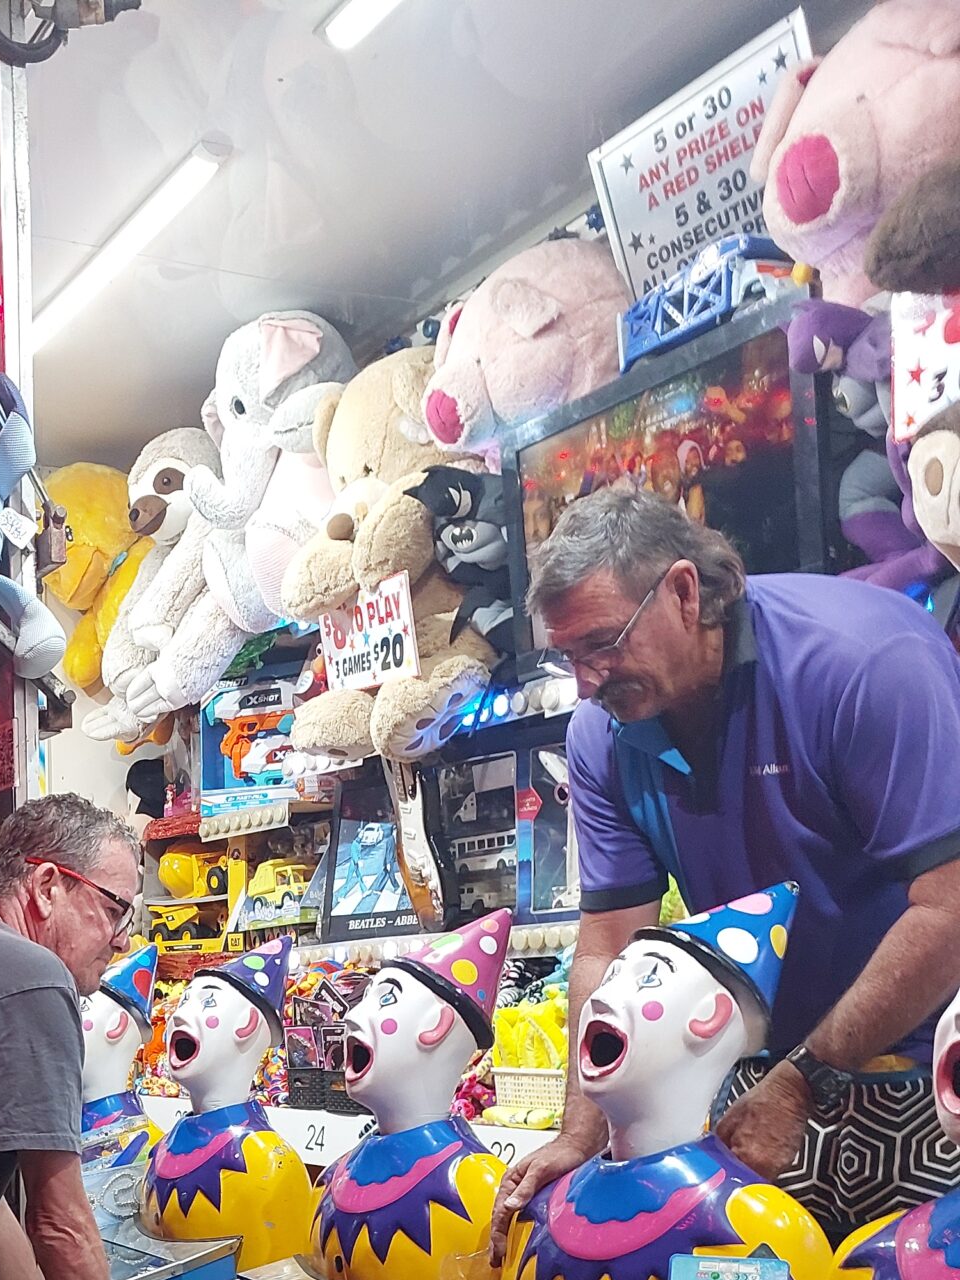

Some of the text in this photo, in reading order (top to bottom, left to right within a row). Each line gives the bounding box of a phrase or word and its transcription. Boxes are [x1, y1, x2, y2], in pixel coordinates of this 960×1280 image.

[653, 86, 732, 153] 5 or 30
[638, 96, 765, 192] ANY PRIZE ON
[647, 192, 659, 211] A
[663, 167, 700, 201] RED
[675, 168, 747, 227] 5 & 30
[366, 591, 400, 628] PLAY
[335, 633, 404, 679] 3 GAMES $20
[231, 938, 240, 947] CAT
[348, 917, 387, 930] BEATLES
[305, 1124, 325, 1152] 24
